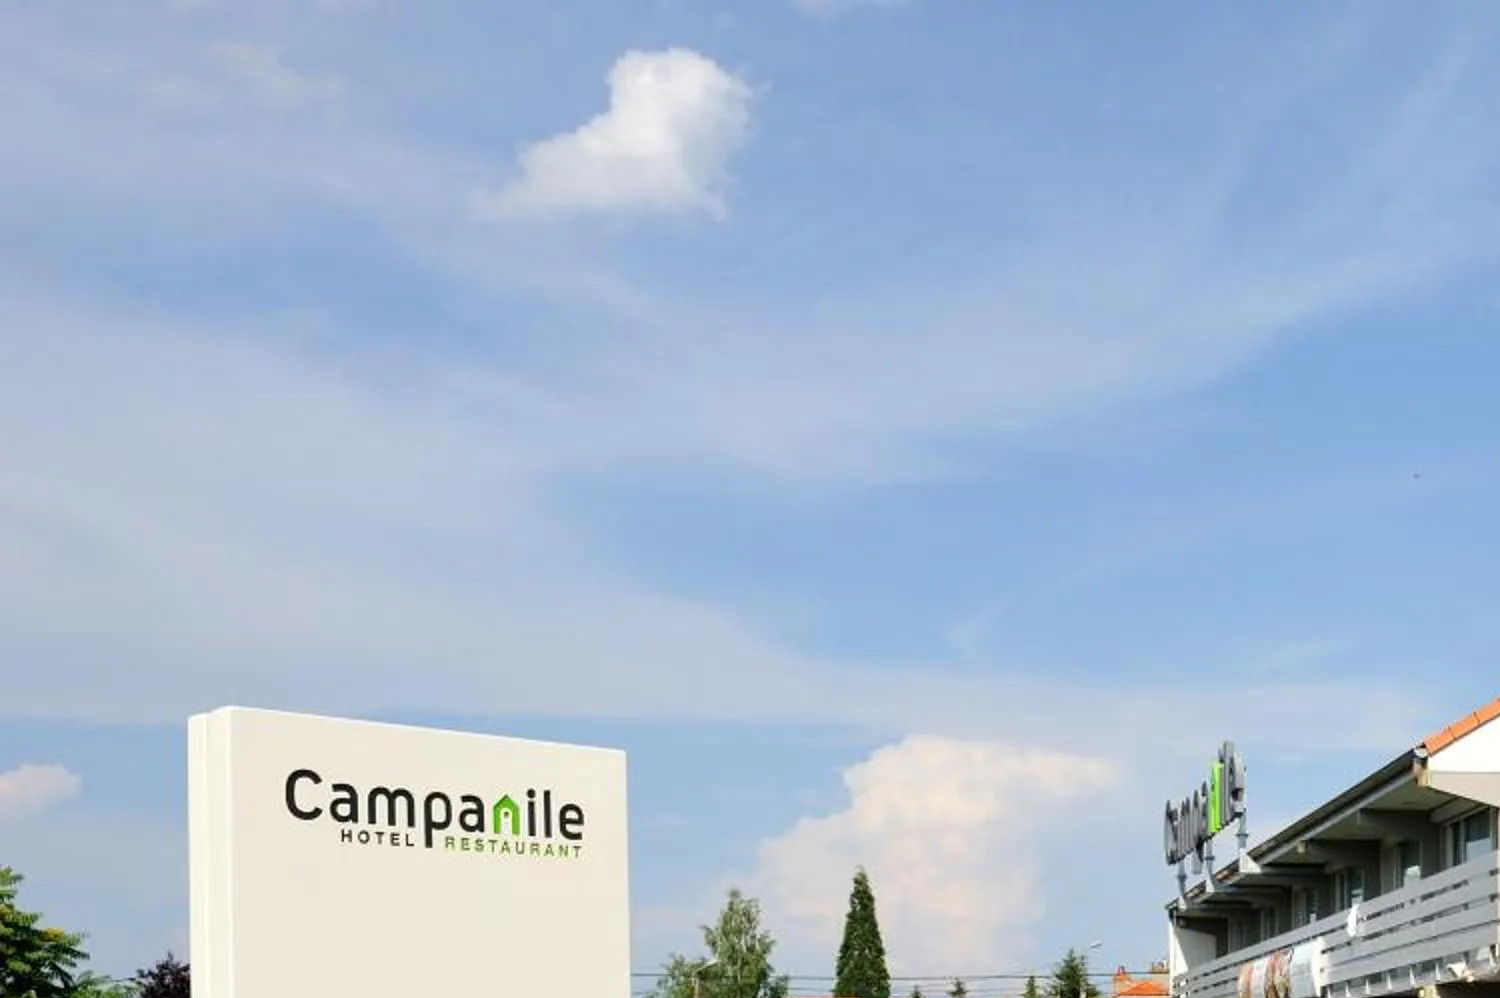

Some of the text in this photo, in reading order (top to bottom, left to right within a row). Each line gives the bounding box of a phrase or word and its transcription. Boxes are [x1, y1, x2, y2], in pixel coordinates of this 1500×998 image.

[285, 768, 585, 848] Campanile
[341, 829, 583, 858] HOTEL RESTAURANT
